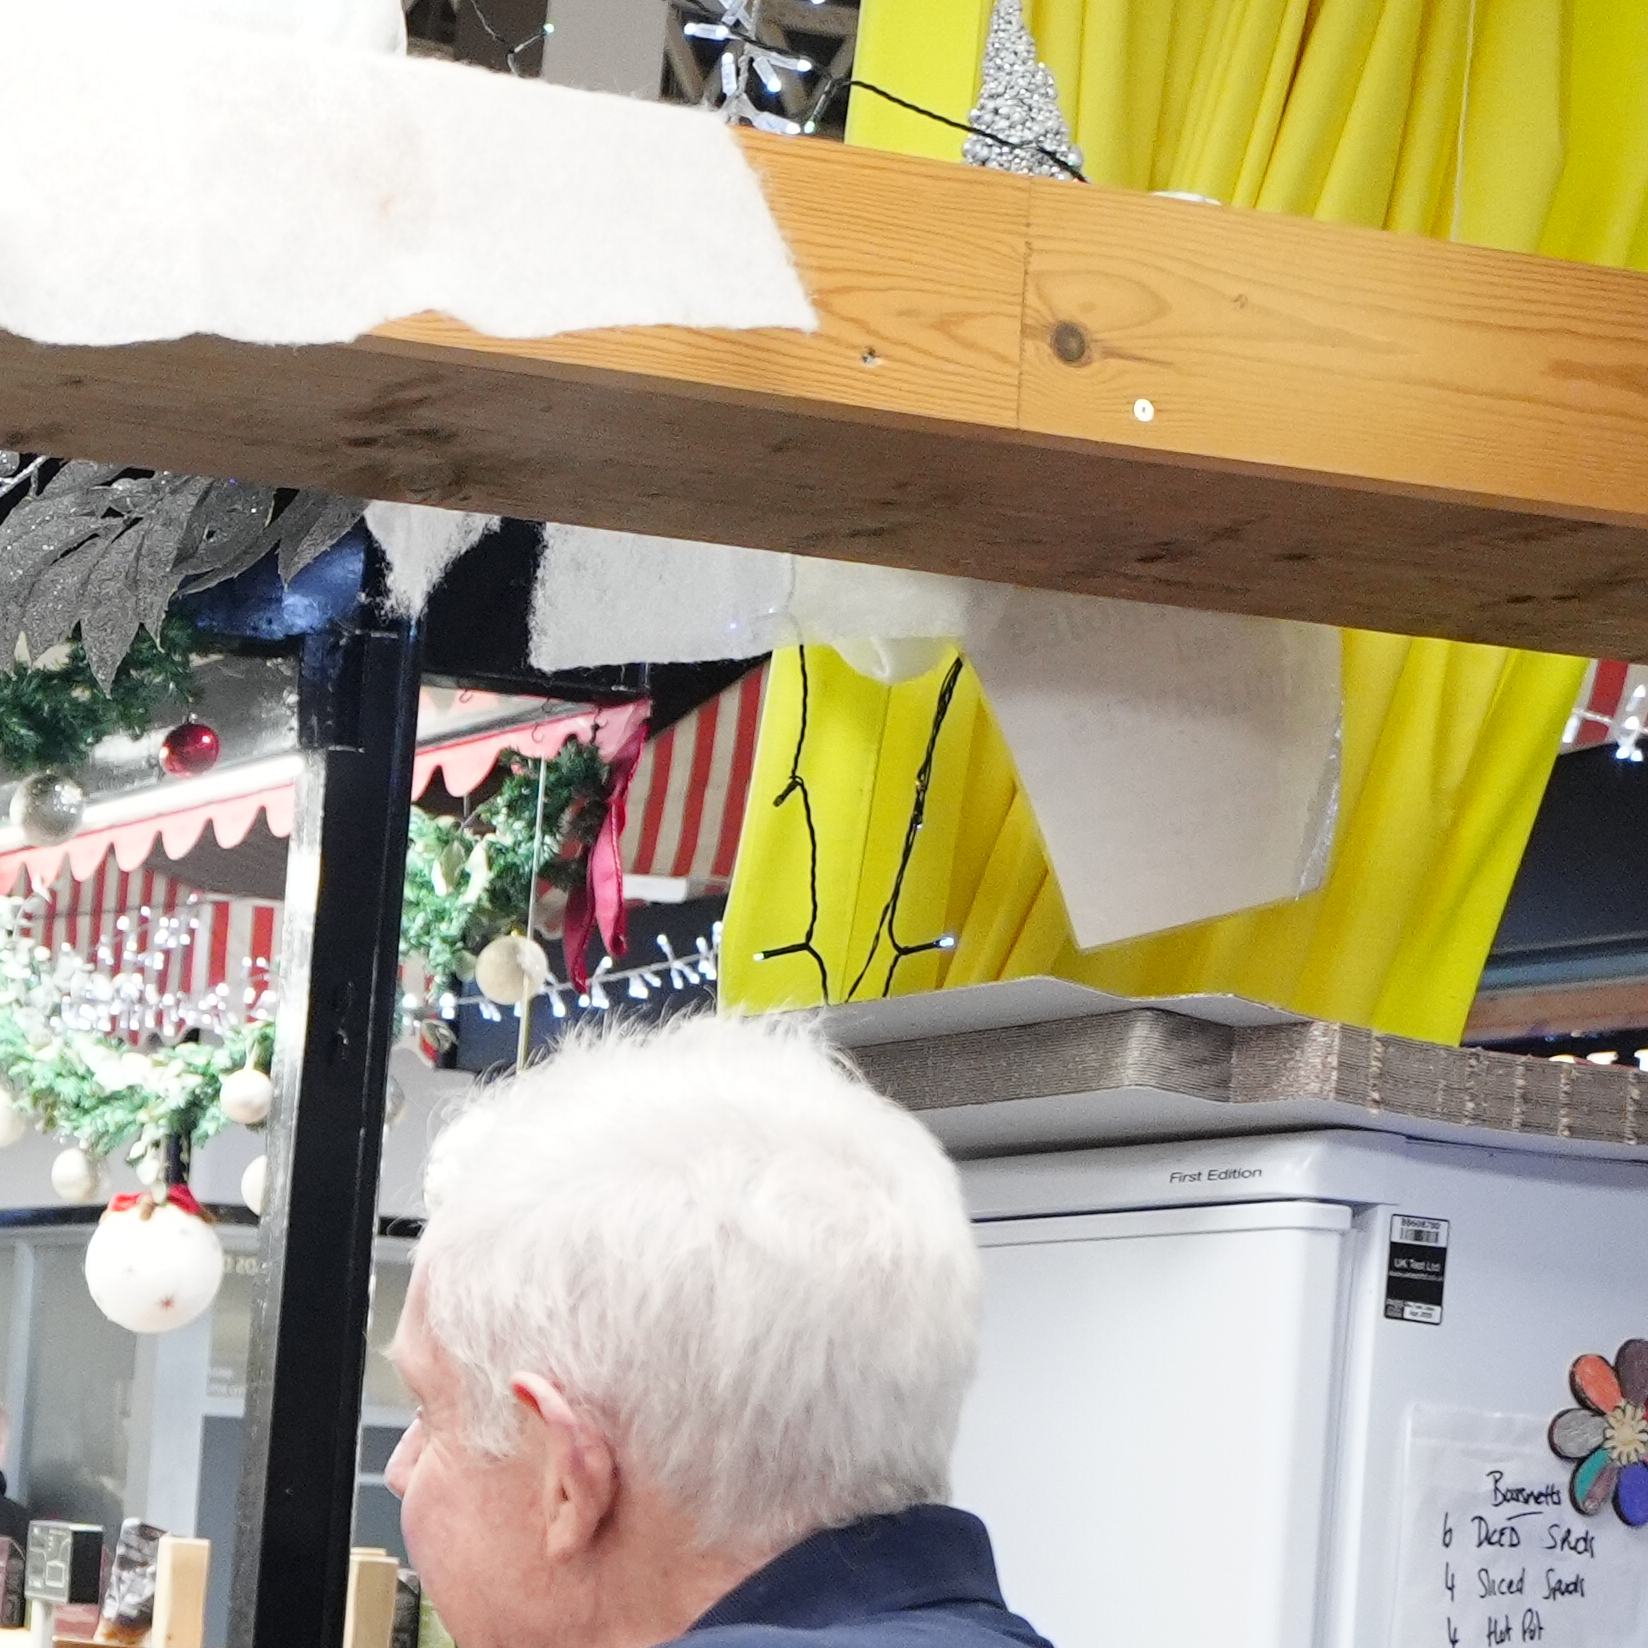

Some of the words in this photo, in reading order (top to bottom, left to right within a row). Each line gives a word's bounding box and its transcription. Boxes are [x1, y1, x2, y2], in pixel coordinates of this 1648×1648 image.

[1169, 1170, 1203, 1184] First
[1207, 1167, 1263, 1182] Edition
[1478, 1566, 1526, 1600] Sliced
[1485, 1614, 1513, 1648] Hot
